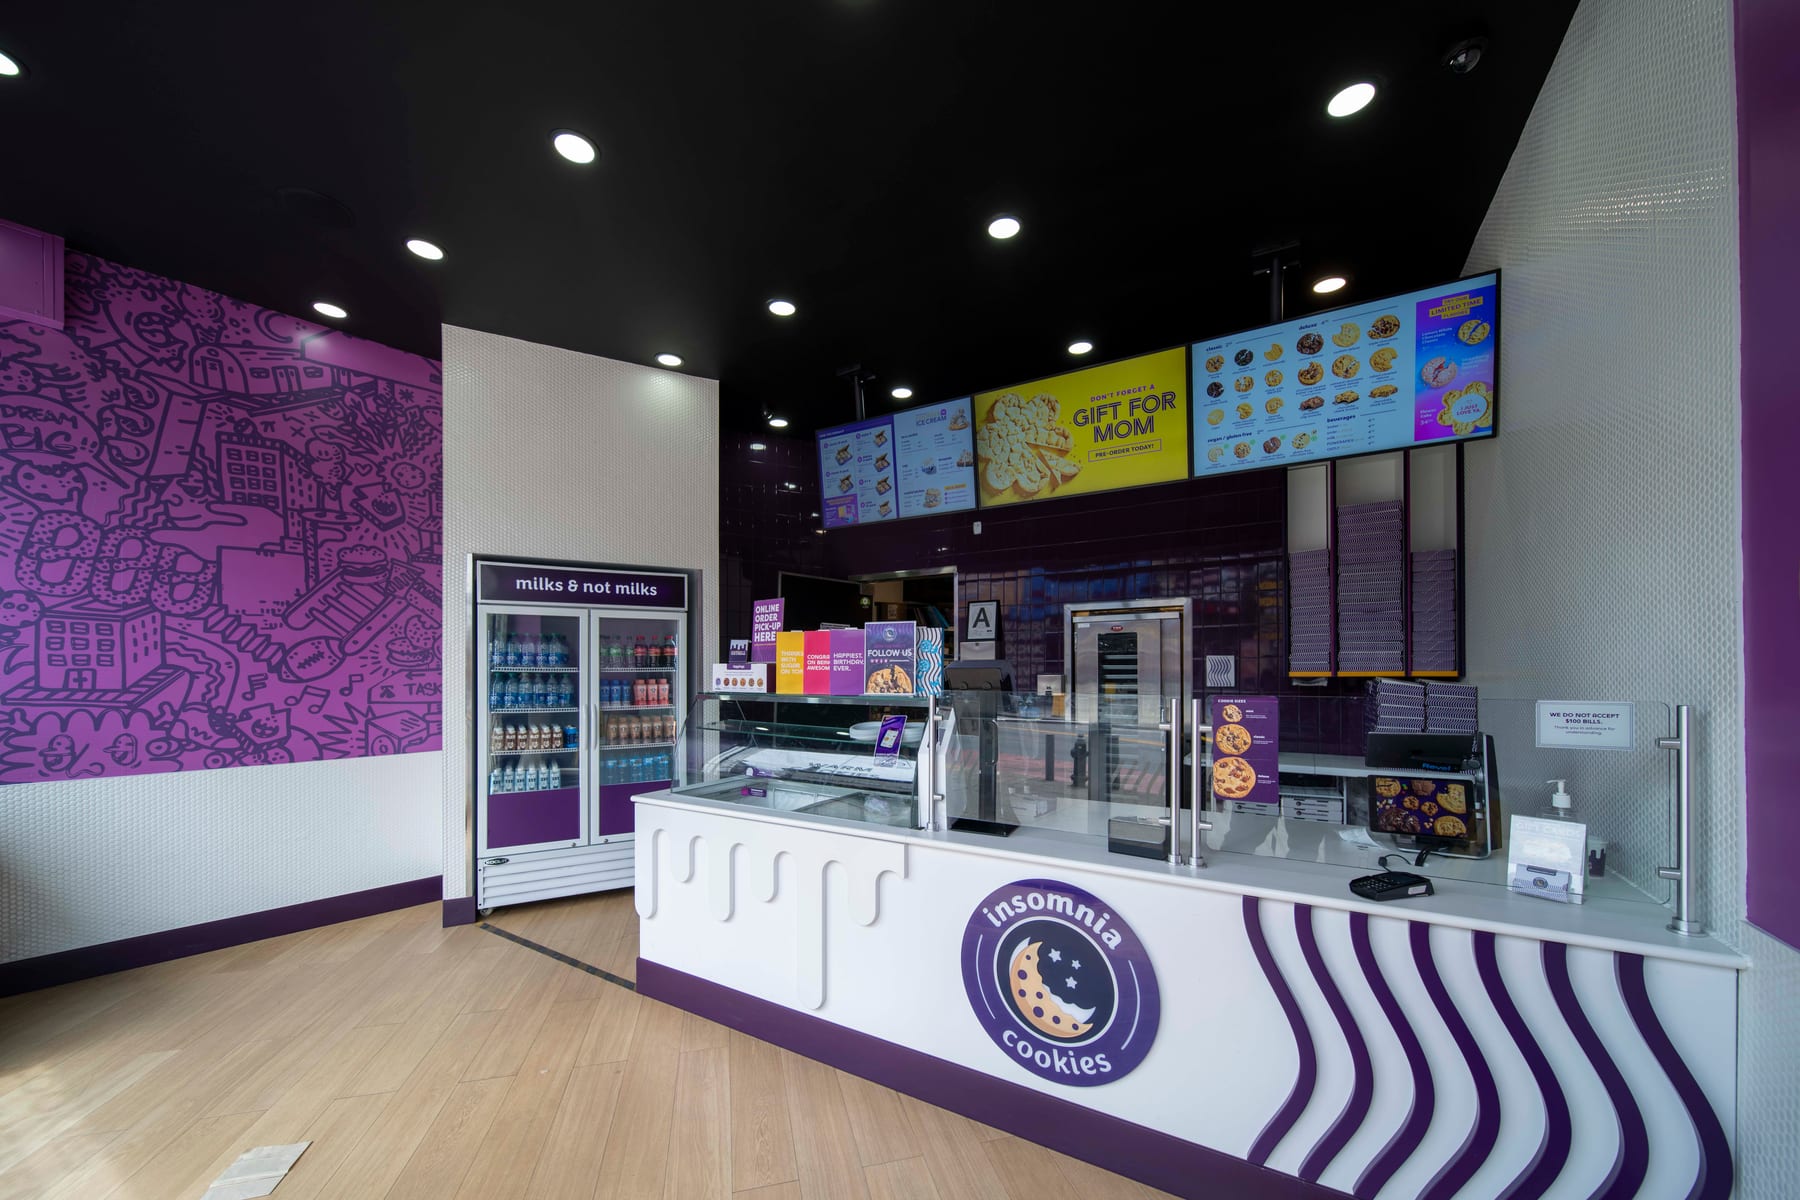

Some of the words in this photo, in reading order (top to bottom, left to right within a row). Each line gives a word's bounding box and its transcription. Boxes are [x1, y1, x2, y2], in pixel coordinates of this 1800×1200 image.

[1431, 304, 1461, 316] LIMITED
[1463, 298, 1481, 308] TIME
[1090, 392, 1114, 402] DON'T
[1116, 386, 1147, 396] FORGET
[0, 404, 78, 429] DREAM
[1073, 401, 1122, 427] GIFT
[1129, 391, 1176, 417] FOR
[1326, 414, 1356, 423] beverages
[1093, 416, 1155, 443] MOM
[1095, 447, 1130, 458] PRE-ORDER
[1131, 443, 1154, 454] TODAY!
[516, 577, 564, 592] milks
[568, 580, 578, 592] &
[584, 581, 611, 594] not
[616, 582, 658, 596] milks
[755, 613, 778, 622] ORDER
[756, 604, 780, 614] ONLINE
[973, 607, 990, 628] A
[754, 622, 781, 630] PICK-UP
[754, 632, 776, 642] HERE
[868, 649, 900, 657] FOLLOW
[982, 892, 1122, 950] insomnia
[1002, 1030, 1112, 1075] cookies
